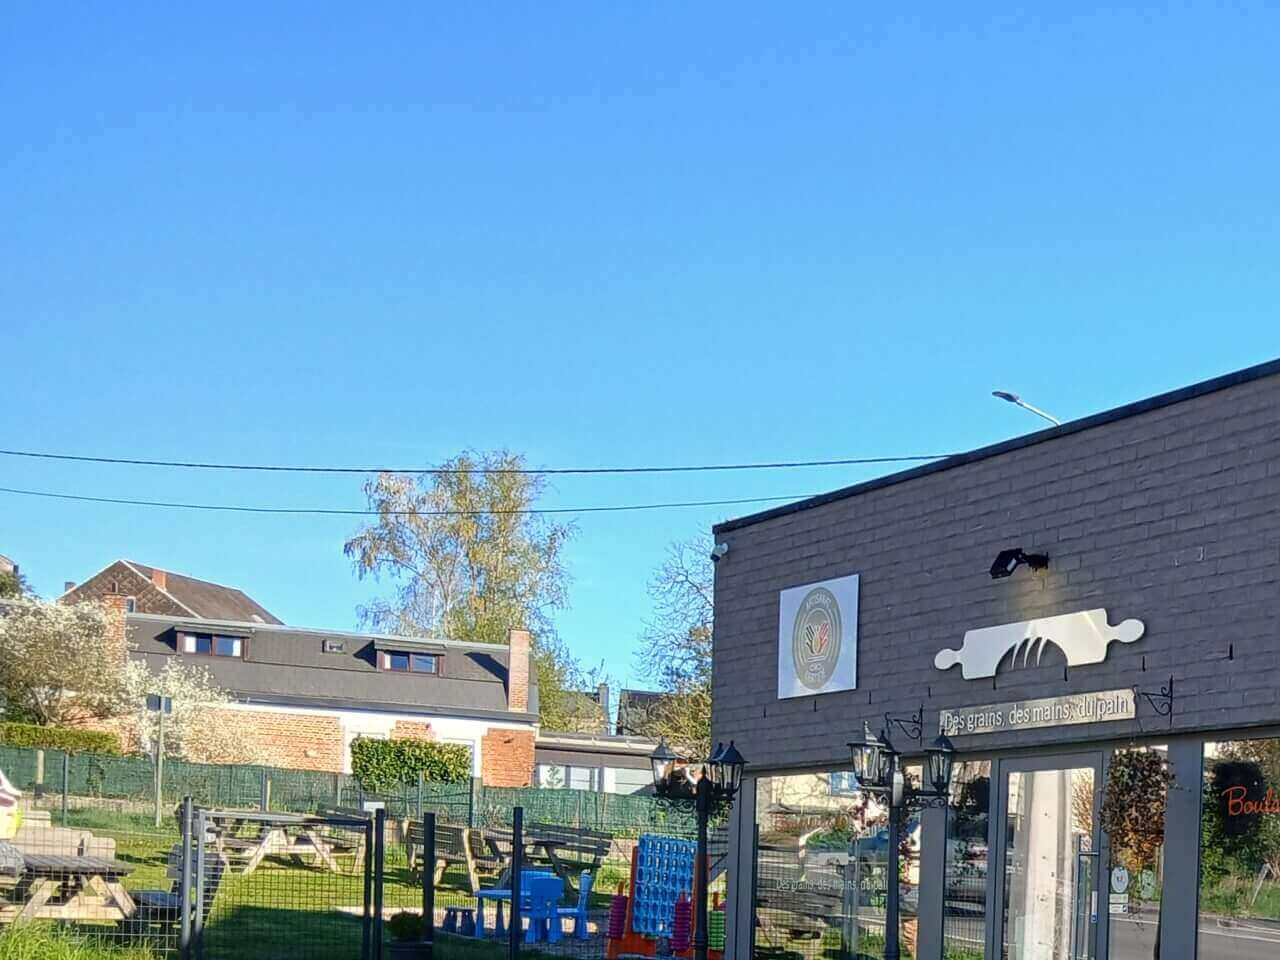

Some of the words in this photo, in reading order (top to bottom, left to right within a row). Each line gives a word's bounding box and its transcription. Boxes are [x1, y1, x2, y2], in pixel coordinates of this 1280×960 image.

[944, 711, 965, 731] Des
[967, 709, 1005, 733] grains,
[1008, 703, 1029, 725] des
[1031, 699, 1074, 722] mains,
[1077, 696, 1093, 718] du
[1096, 693, 1129, 721] pain
